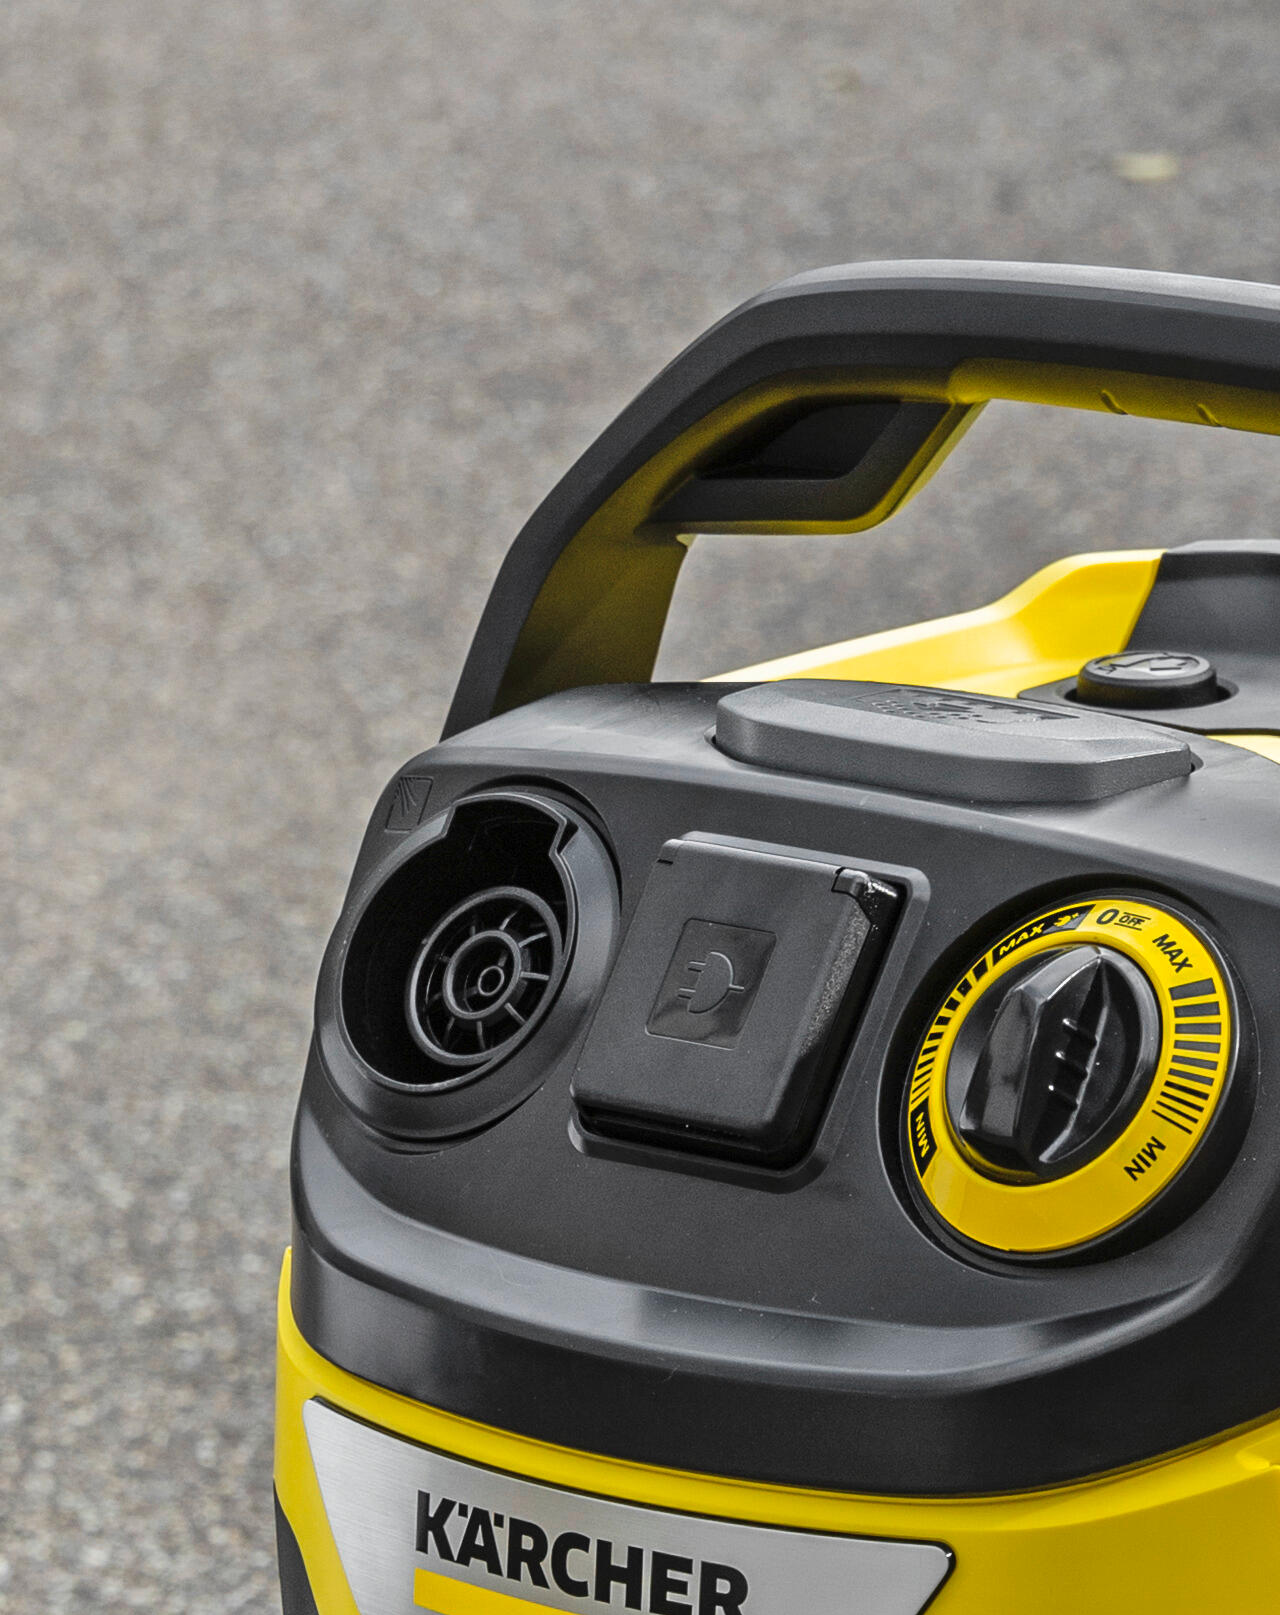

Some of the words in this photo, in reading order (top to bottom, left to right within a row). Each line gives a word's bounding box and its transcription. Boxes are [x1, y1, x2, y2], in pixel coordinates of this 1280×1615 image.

[999, 922, 1045, 956] MAX
[1118, 914, 1146, 927] OFF
[1152, 933, 1194, 974] MAX
[915, 1111, 930, 1158] MIN
[1123, 1135, 1166, 1181] MIN
